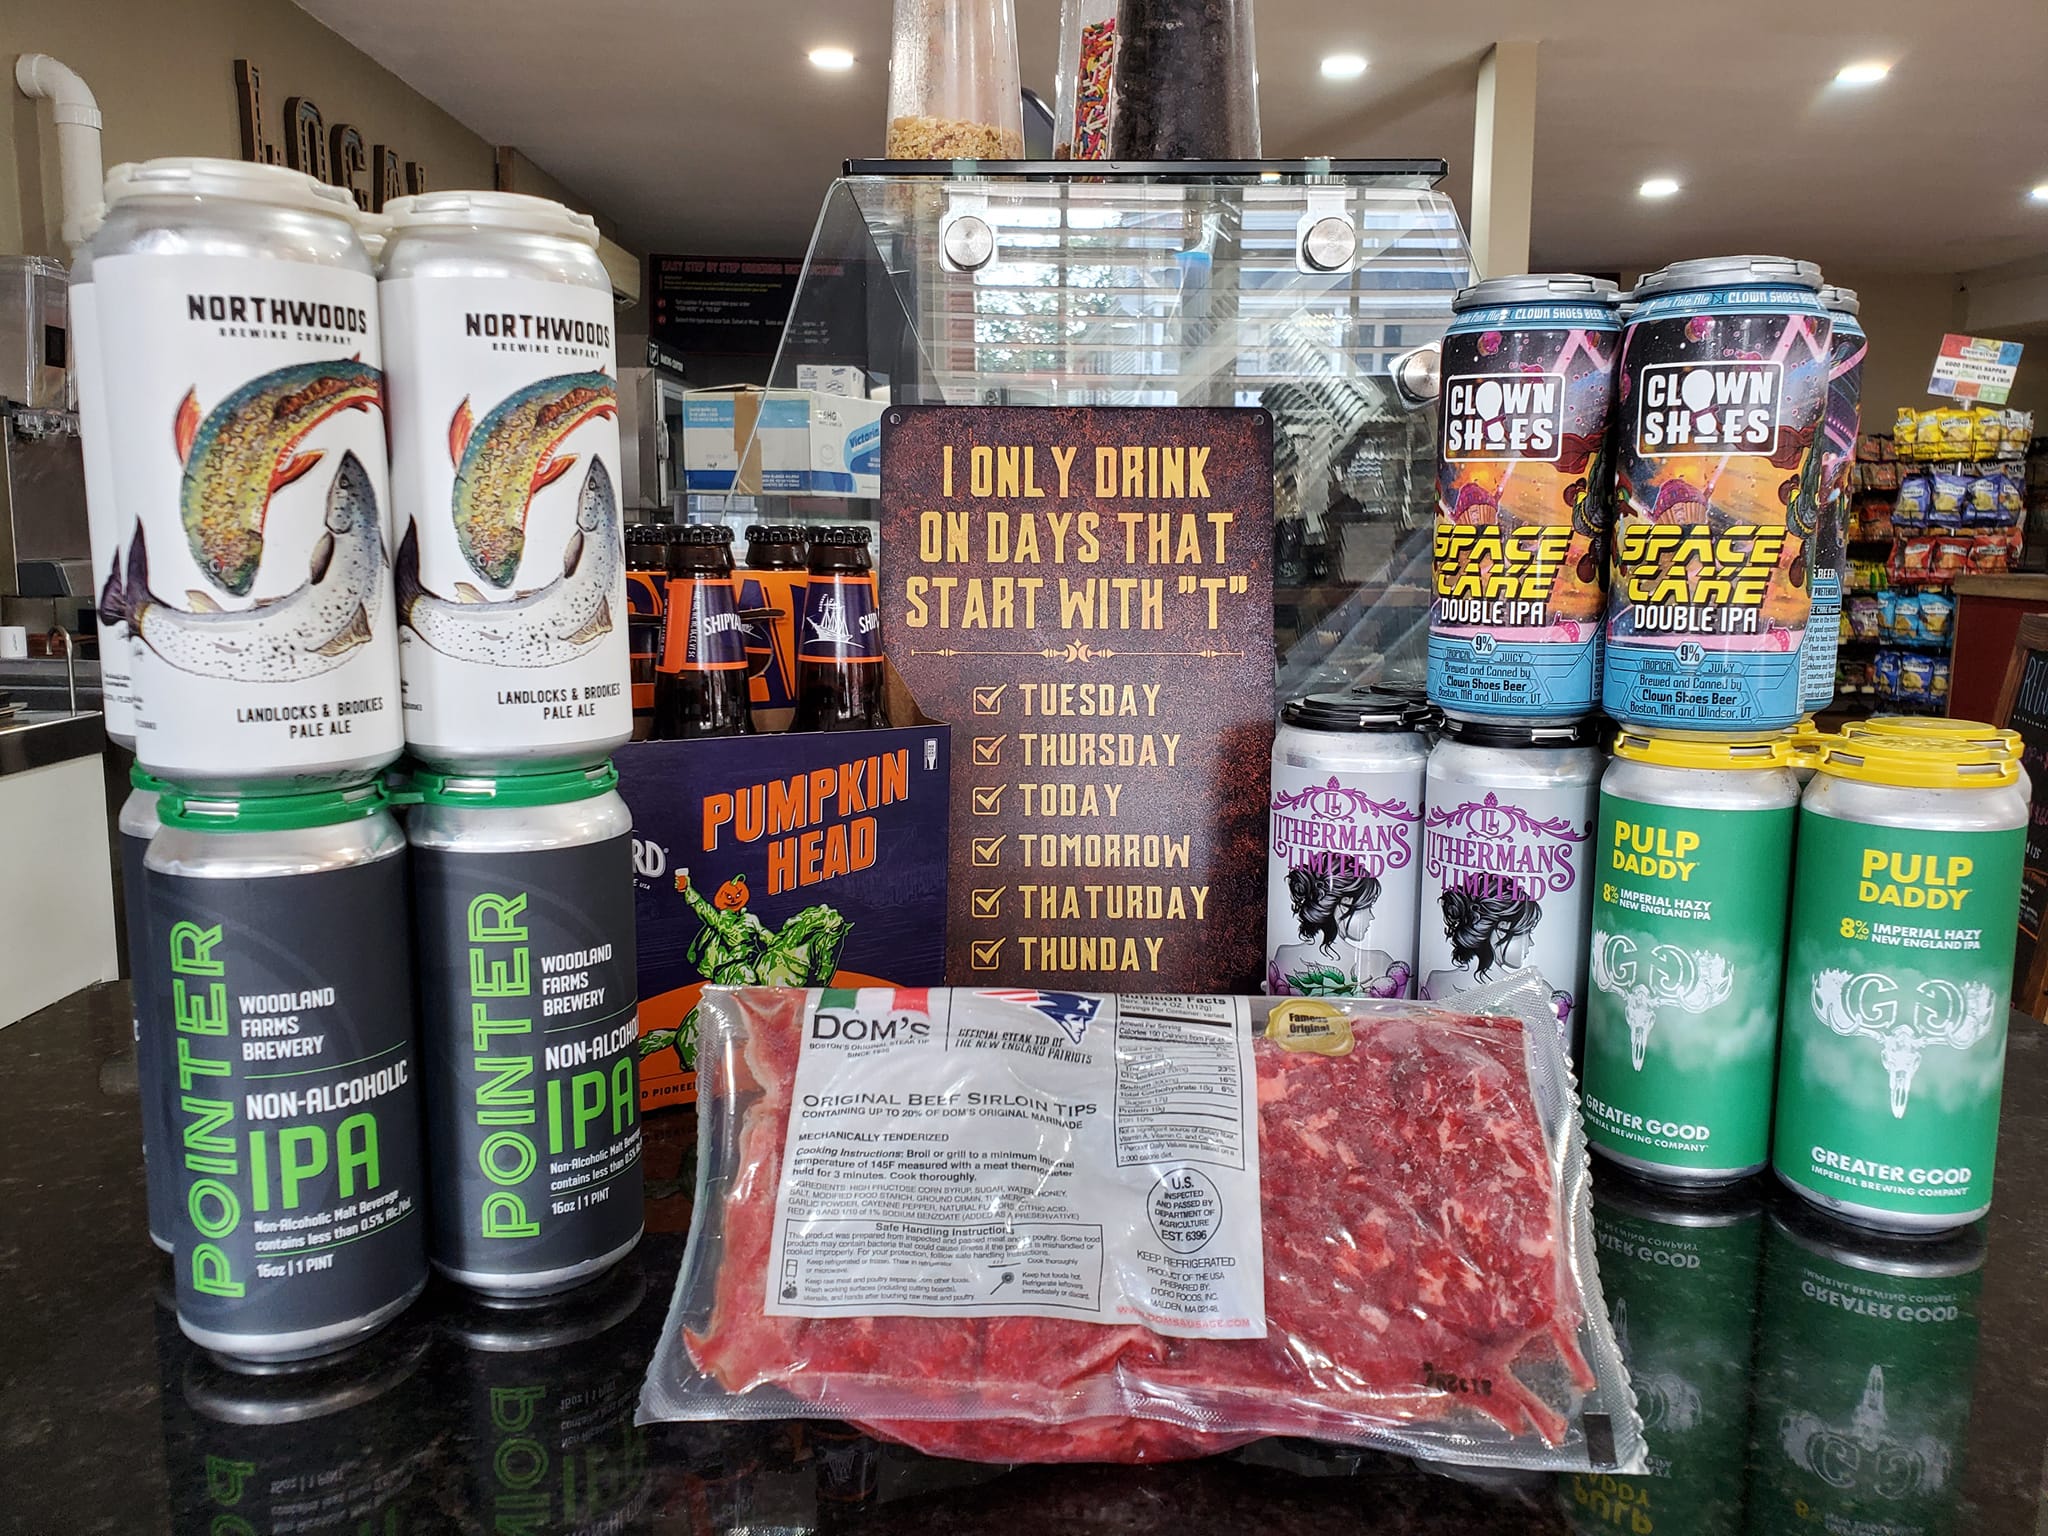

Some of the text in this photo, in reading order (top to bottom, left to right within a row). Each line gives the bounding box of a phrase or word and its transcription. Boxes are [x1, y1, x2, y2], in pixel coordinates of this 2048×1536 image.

[1728, 291, 1799, 304] CLOWN SHOES
[187, 294, 367, 334] NORTHWOODS
[1514, 309, 1551, 320] CLOWN
[1553, 308, 1583, 320] SHOES
[219, 327, 351, 345] BREWING COMPANY
[465, 312, 610, 349] NORTHWOODS
[493, 343, 600, 359] BREWING COMPANY
[1451, 381, 1555, 418] CLOWN
[1649, 369, 1773, 408] CLOWN
[1449, 418, 1553, 451] SHOES
[1645, 409, 1770, 445] SHOES
[943, 446, 1211, 499] I ONLY DRINK
[920, 511, 1234, 564] ON DAYS THAT
[1434, 524, 1572, 561] SPACE
[1622, 525, 1786, 563] SPACE
[905, 575, 1248, 630] START WITH "T"
[1441, 598, 1544, 625] DOUBLE IPA
[1635, 605, 1757, 633] DOUBLE IPA
[1475, 635, 1492, 652] 9%
[1680, 644, 1700, 663] 9%
[1642, 659, 1735, 673] TROPICAL JUICY
[498, 683, 621, 705] LANDLOCKS & BROOKIES
[1639, 674, 1742, 692] Brewed and Canned by
[1642, 688, 1737, 705] Clown Shoes Beer
[237, 697, 384, 723] LANDLOCKS & BROOKIES
[543, 703, 596, 720] PALE ALE
[1019, 683, 1161, 717] TUESDAY
[1661, 704, 1675, 715] MA
[1677, 706, 1694, 717] and
[1740, 707, 1751, 718] VT
[289, 720, 352, 739] PALE ALE
[1019, 733, 1181, 767] THURSDAY
[703, 748, 909, 852] PUMPKIN
[1019, 783, 1123, 817] TODAY
[1018, 834, 1191, 868] TOMORROW
[1273, 813, 1411, 868] LITHERMANS
[1615, 820, 1700, 858] PULP
[767, 816, 877, 896] HEAD
[1288, 846, 1385, 878] LIMITED
[1426, 830, 1576, 892] LITHERMANS
[1613, 849, 1696, 882] DADDY
[1862, 849, 1973, 886] PULP
[1441, 868, 1546, 901] LIMITED
[1603, 883, 1712, 911] 8% IMPERIAL HAZY
[1858, 881, 1968, 910] DADDY
[1018, 885, 1210, 920] THATURDAY
[1619, 899, 1711, 920] NEW ENGLAND IPA
[1840, 917, 1982, 940] 8% IMPERIAL HAZY
[1871, 934, 1981, 950] NEW ENGLAND IPA
[541, 943, 612, 974] WOODLAND
[1018, 937, 1164, 971] THUNDAY
[542, 971, 589, 995] FARMS
[239, 987, 335, 1014] WOODLAND
[543, 988, 605, 1017] BREWERY
[240, 1016, 300, 1038] FARMS
[812, 1014, 931, 1041] DOM'S
[1002, 1031, 1031, 1044] STEAK
[1035, 1034, 1050, 1045] TIP
[1289, 1024, 1330, 1033] Original
[242, 1035, 324, 1061] BREWERY
[955, 1038, 1092, 1065] THE NEW ENGLAND PATRIOTS
[467, 892, 540, 1239] POINTER
[246, 1059, 408, 1120] NON-ALCOHOLIC
[170, 920, 246, 1298] POINTER
[547, 1056, 634, 1155] IPA
[803, 1092, 1097, 1117] ORIGINAL BEEF SIRLOIN TIPS
[798, 1131, 949, 1142] MECHANICALLY TENDERIZED
[249, 1112, 380, 1213] IPA
[1811, 1146, 1972, 1185] GREATER GOOD
[1164, 1190, 1203, 1200] INSPECTED
[1172, 1177, 1194, 1189] U.S.
[1811, 1165, 1969, 1198] IMPERIAL BREWING COMPANY
[254, 1190, 399, 1234] Non-Alcoholic Malt Beverage
[1155, 1209, 1215, 1218] DEPARTMENT OF
[1159, 1219, 1209, 1229] AGRICULTURE
[255, 1214, 384, 1252] contains less than 0.5%
[1161, 1230, 1207, 1242] EST. 6396
[256, 1262, 286, 1279] 16oz
[306, 1253, 334, 1273] PINT
[1136, 1250, 1236, 1268] KEEP REFRIGERATED
